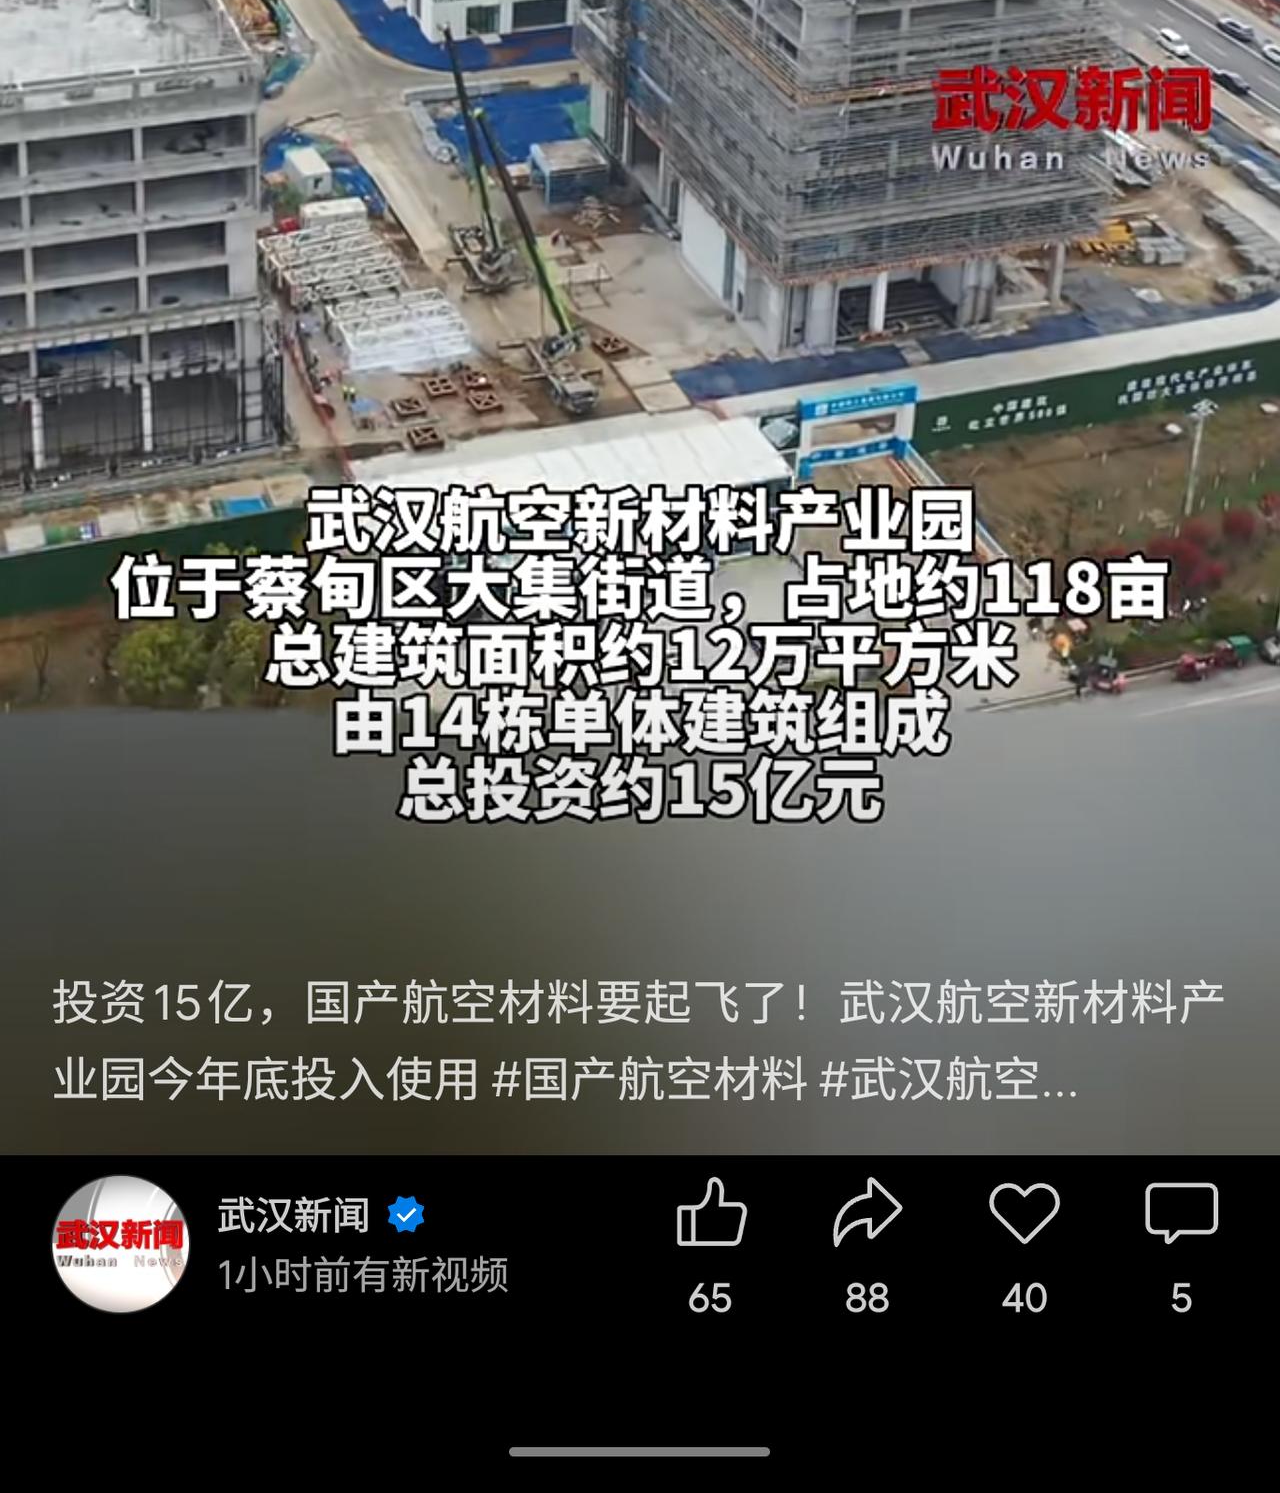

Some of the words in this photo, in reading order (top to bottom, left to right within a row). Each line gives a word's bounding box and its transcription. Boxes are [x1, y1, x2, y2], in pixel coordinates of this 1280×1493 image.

[54, 1056, 476, 1100] 业园今年底投入使用
[492, 1056, 807, 1100] #国产航空材料
[218, 1196, 368, 1233] 武汉新闻
[56, 1218, 184, 1250] 武汉新闻
[220, 1256, 508, 1292] 1小时前有新视频
[689, 1283, 731, 1312] 65
[846, 1283, 889, 1312] 88
[1002, 1283, 1047, 1312] 40
[1172, 1283, 1191, 1312] 5
